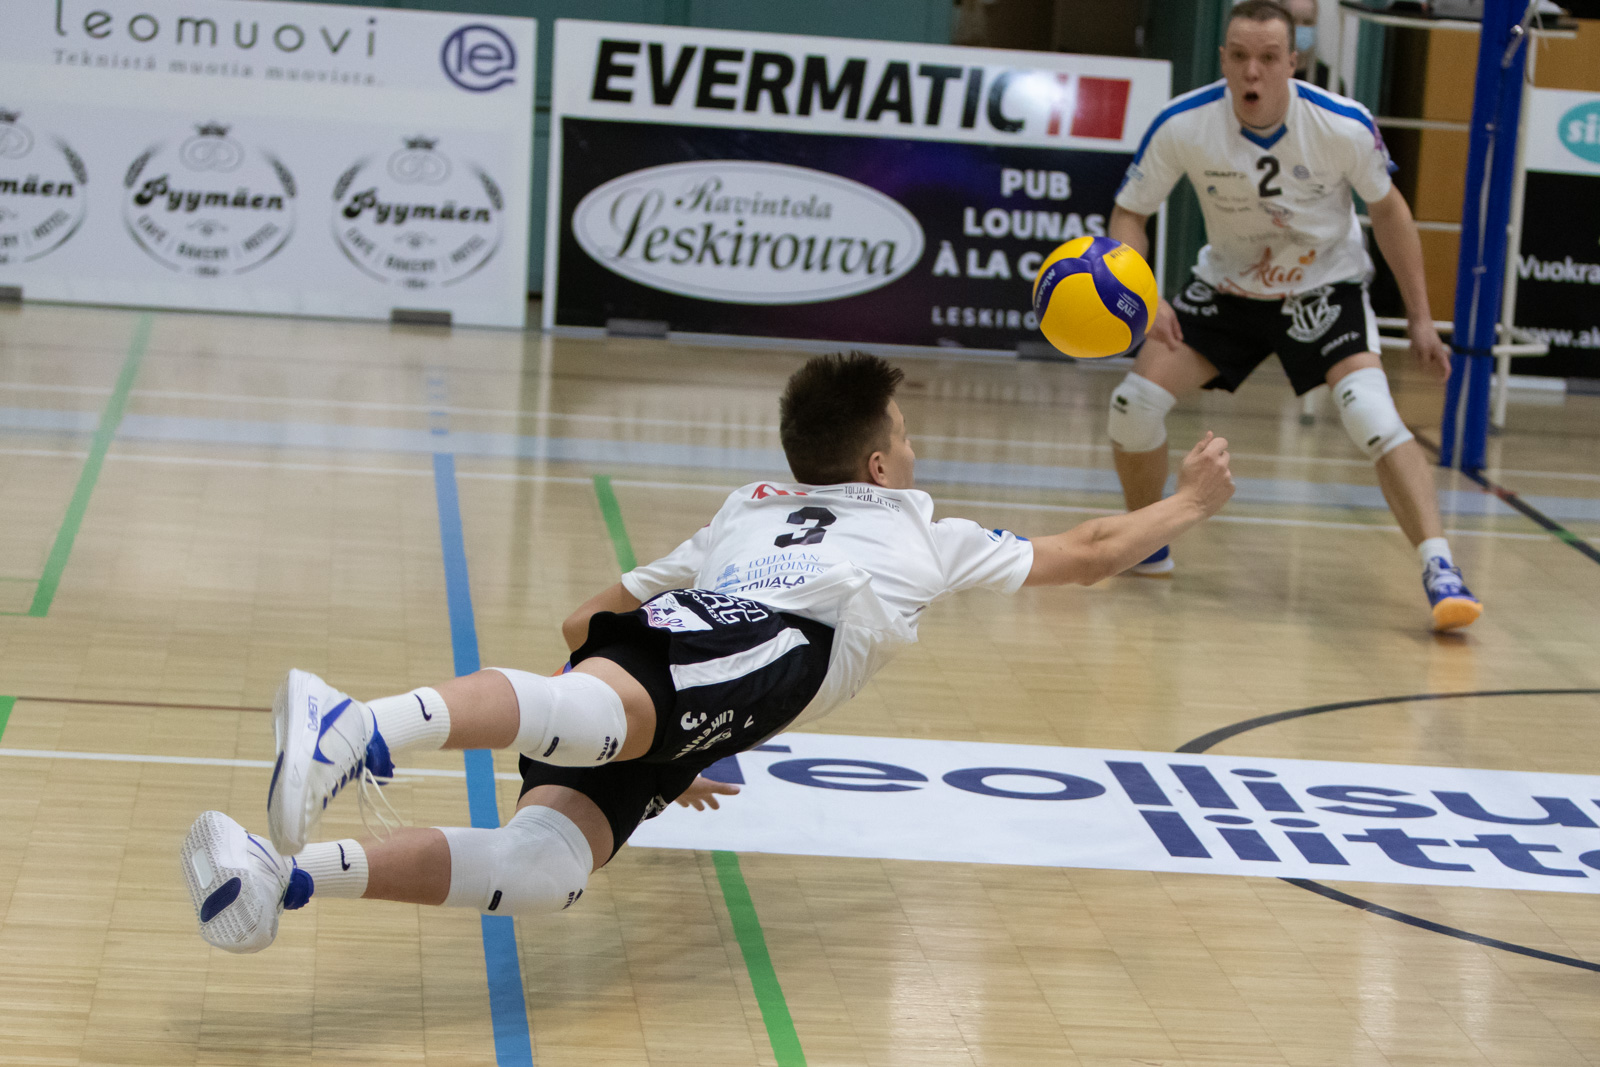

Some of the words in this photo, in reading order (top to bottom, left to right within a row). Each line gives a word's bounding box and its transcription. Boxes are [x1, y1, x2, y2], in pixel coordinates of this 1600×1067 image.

[55, 0, 377, 57] leomuovi
[591, 38, 1028, 134] EVERMATIC
[1567, 113, 1600, 145] si
[0, 174, 74, 198] mäen
[134, 174, 284, 212] Pyymäen
[1000, 168, 1071, 199] PUB
[1257, 154, 1283, 198] 2
[342, 187, 491, 224] Pyymäen
[674, 175, 834, 220] Ravintola
[963, 206, 1106, 240] LOUNAS
[967, 249, 1012, 279] LA
[1017, 252, 1044, 281] C
[931, 307, 1040, 331] LESKIRO
[774, 506, 838, 549] 3
[744, 561, 825, 583] TILITOIMIS
[701, 744, 1600, 828] Teollisu
[1139, 809, 1600, 879] liitt
